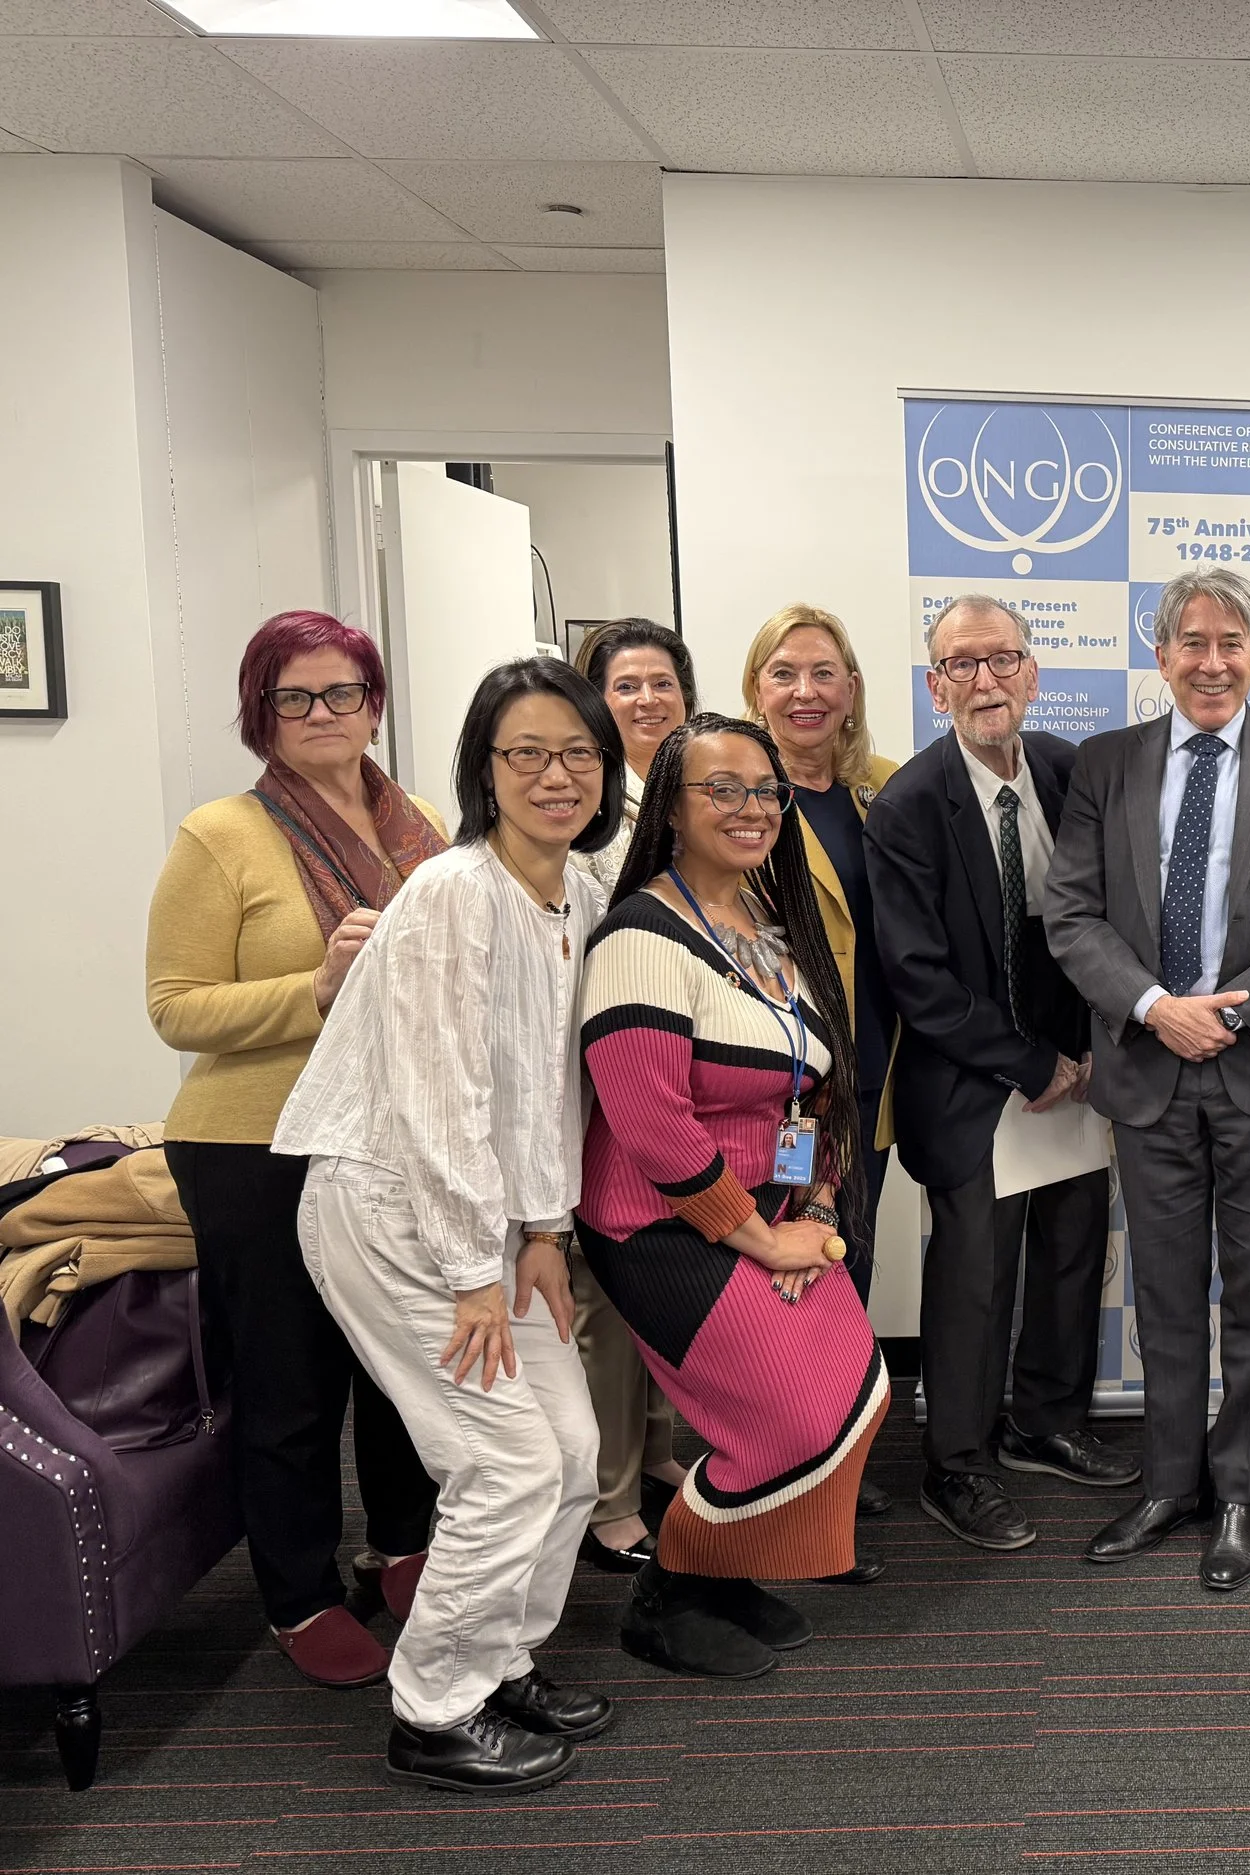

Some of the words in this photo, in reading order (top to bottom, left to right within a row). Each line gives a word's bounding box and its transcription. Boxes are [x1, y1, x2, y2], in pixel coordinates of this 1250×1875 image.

[1149, 423, 1233, 437] CONFERENCE
[1148, 439, 1238, 452] CONSULTATIVE
[1148, 454, 1181, 466] WITH
[1183, 455, 1208, 467] THE
[1147, 516, 1190, 536] 75th
[1021, 599, 1078, 612] Present
[1026, 617, 1065, 629] uture
[1078, 635, 1117, 648] Now!
[1039, 691, 1073, 703] NGOs
[1075, 692, 1088, 703] IN
[1025, 706, 1110, 718] RELATIONSHIP
[1043, 720, 1096, 732] NATIONS
